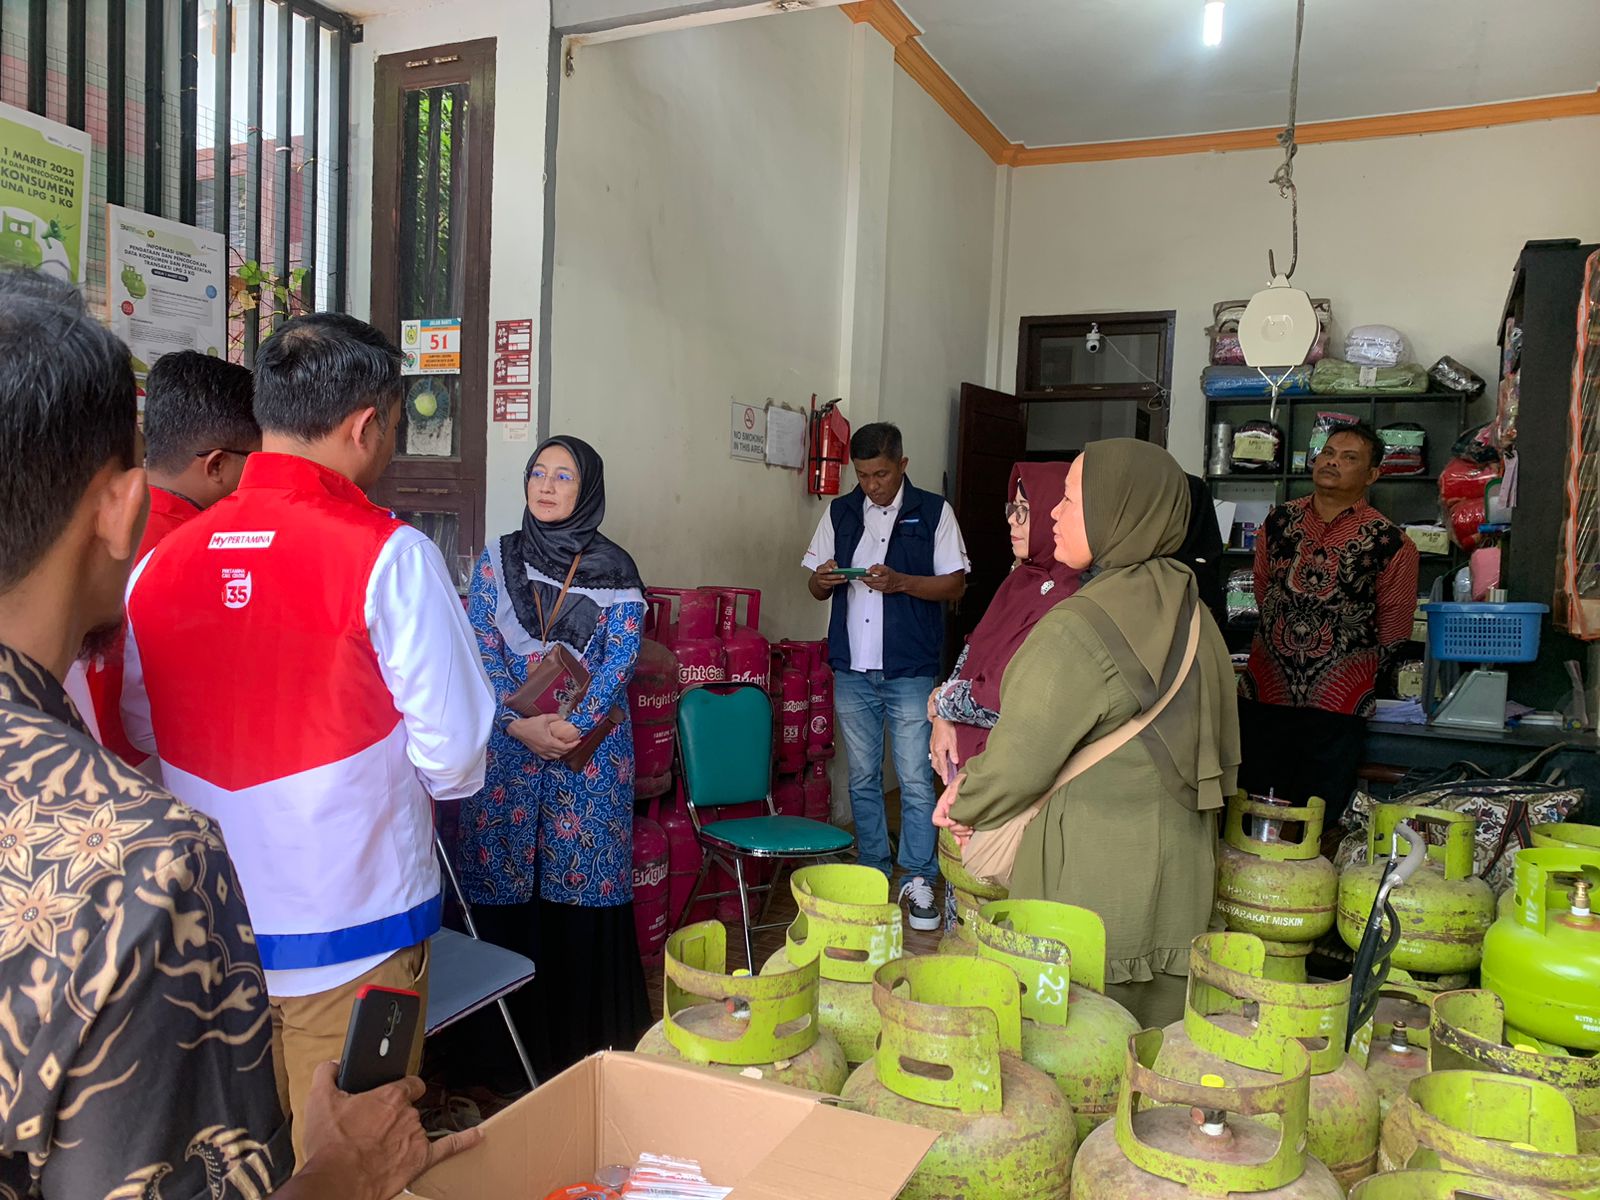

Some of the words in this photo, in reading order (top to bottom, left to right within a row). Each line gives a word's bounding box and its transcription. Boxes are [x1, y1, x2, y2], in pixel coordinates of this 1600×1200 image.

[13, 150, 47, 168] MARET
[50, 163, 74, 177] 2023
[0, 167, 74, 198] KONSUMEN
[9, 161, 24, 170] DAN
[26, 165, 74, 186] PENCOCOKAN
[27, 187, 46, 200] LPG
[49, 195, 55, 203] 3
[59, 198, 73, 208] KG
[430, 334, 448, 350] 51
[733, 430, 741, 440] NO
[742, 432, 764, 444] SMOKING
[733, 441, 739, 450] IN
[739, 442, 750, 452] THIS
[751, 444, 764, 454] AREA
[679, 665, 705, 684] ght
[706, 665, 725, 680] Gas
[638, 692, 671, 709] Bright
[1272, 916, 1304, 927] MISKIN
